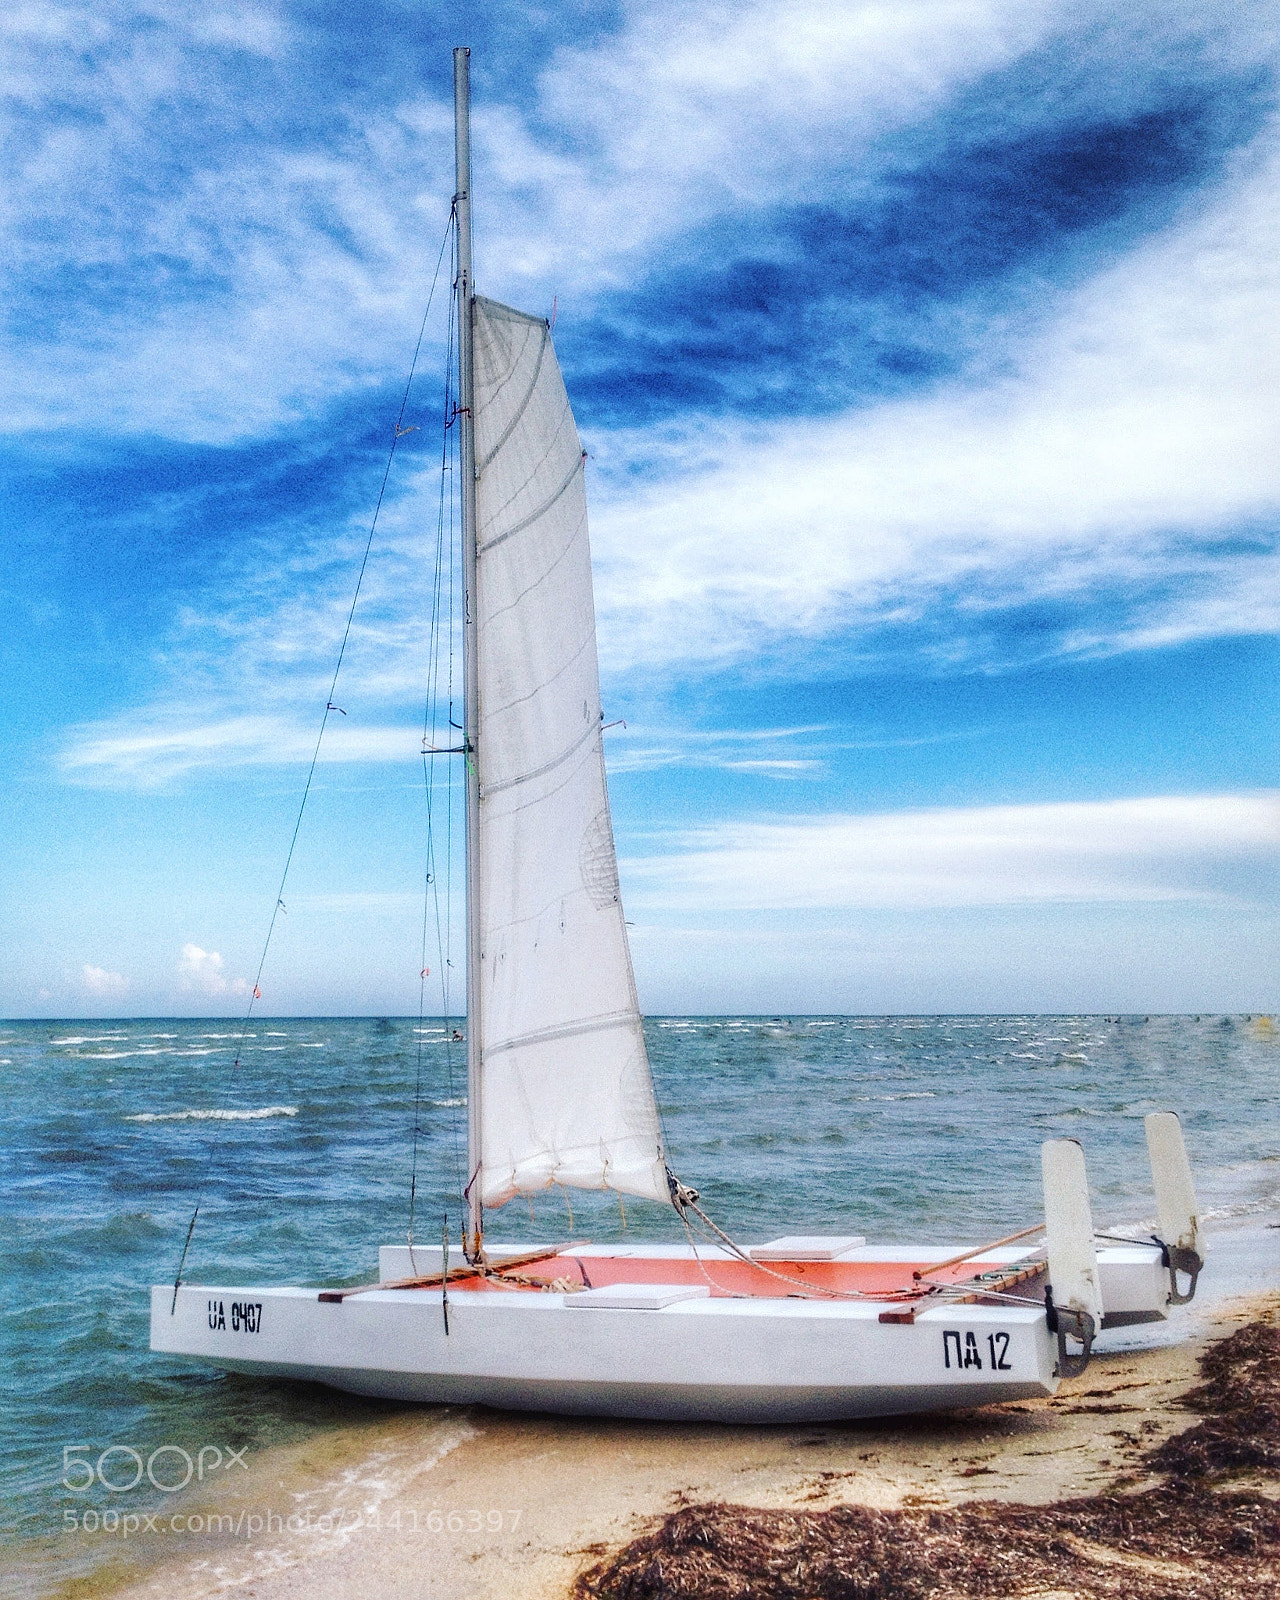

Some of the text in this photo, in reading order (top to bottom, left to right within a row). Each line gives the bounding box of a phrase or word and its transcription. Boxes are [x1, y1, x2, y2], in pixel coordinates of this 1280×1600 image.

[208, 1300, 263, 1333] UA 0407
[986, 1331, 1012, 1370] 12
